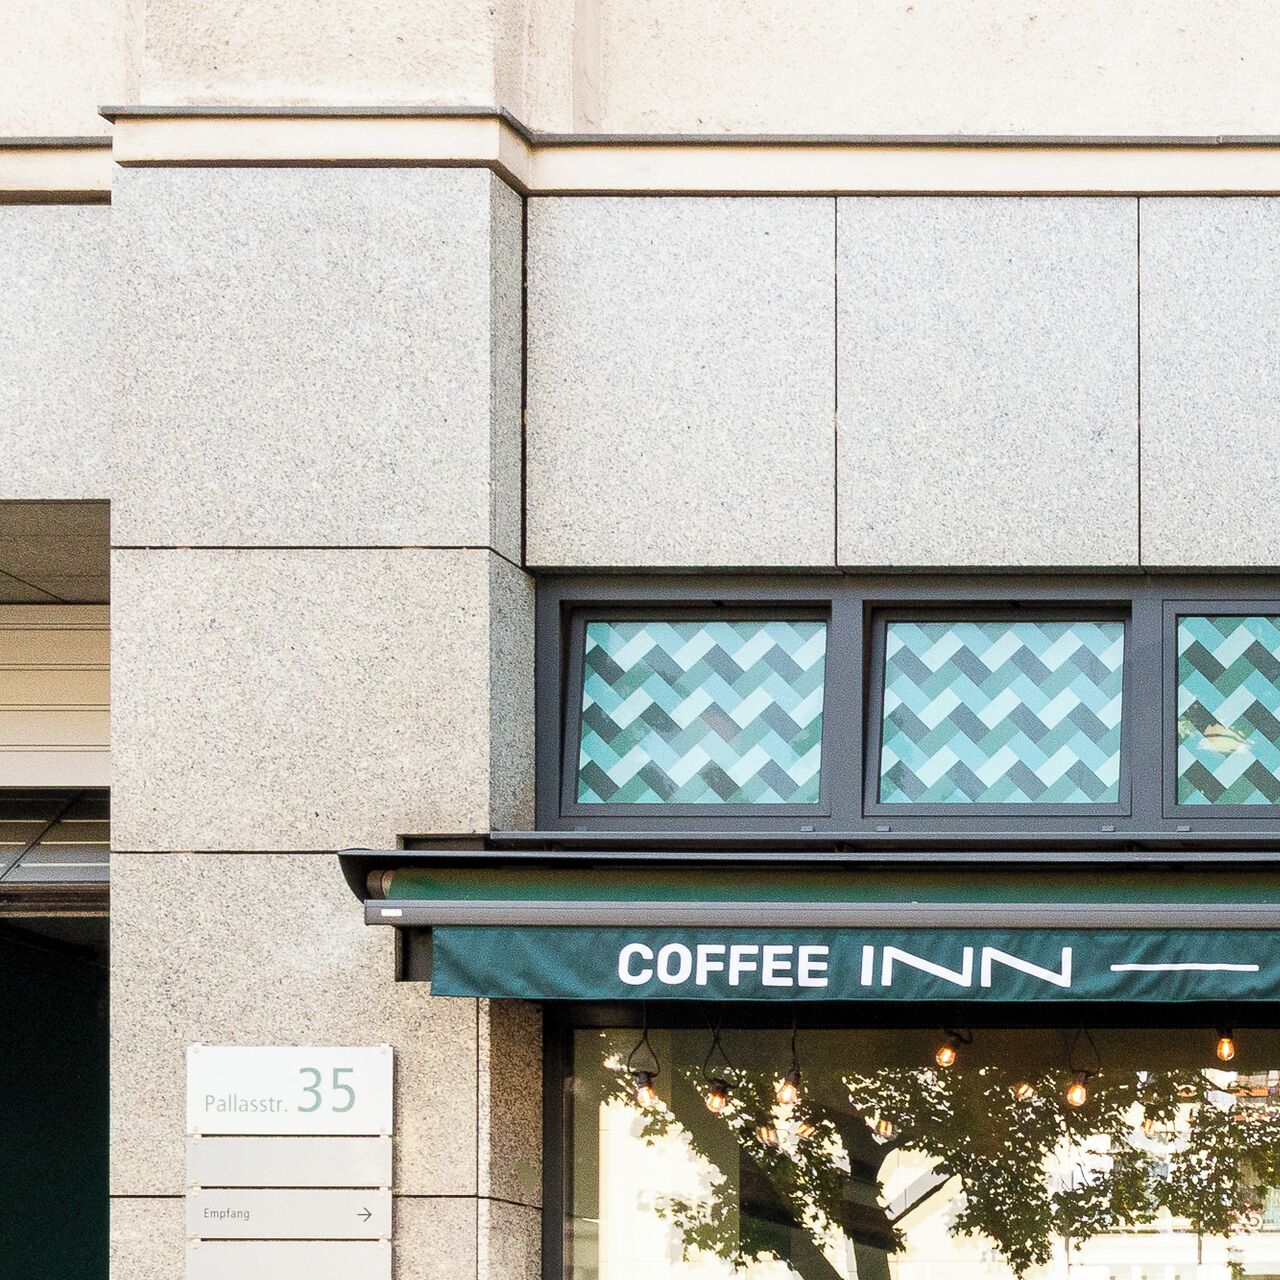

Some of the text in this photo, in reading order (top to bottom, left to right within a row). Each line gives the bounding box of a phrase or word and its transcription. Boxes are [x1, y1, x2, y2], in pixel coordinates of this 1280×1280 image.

[618, 943, 829, 987] COFFEE
[860, 945, 1073, 988] INN
[204, 1066, 356, 1113] Pallasstr. 35
[203, 1207, 250, 1221] Empfang
